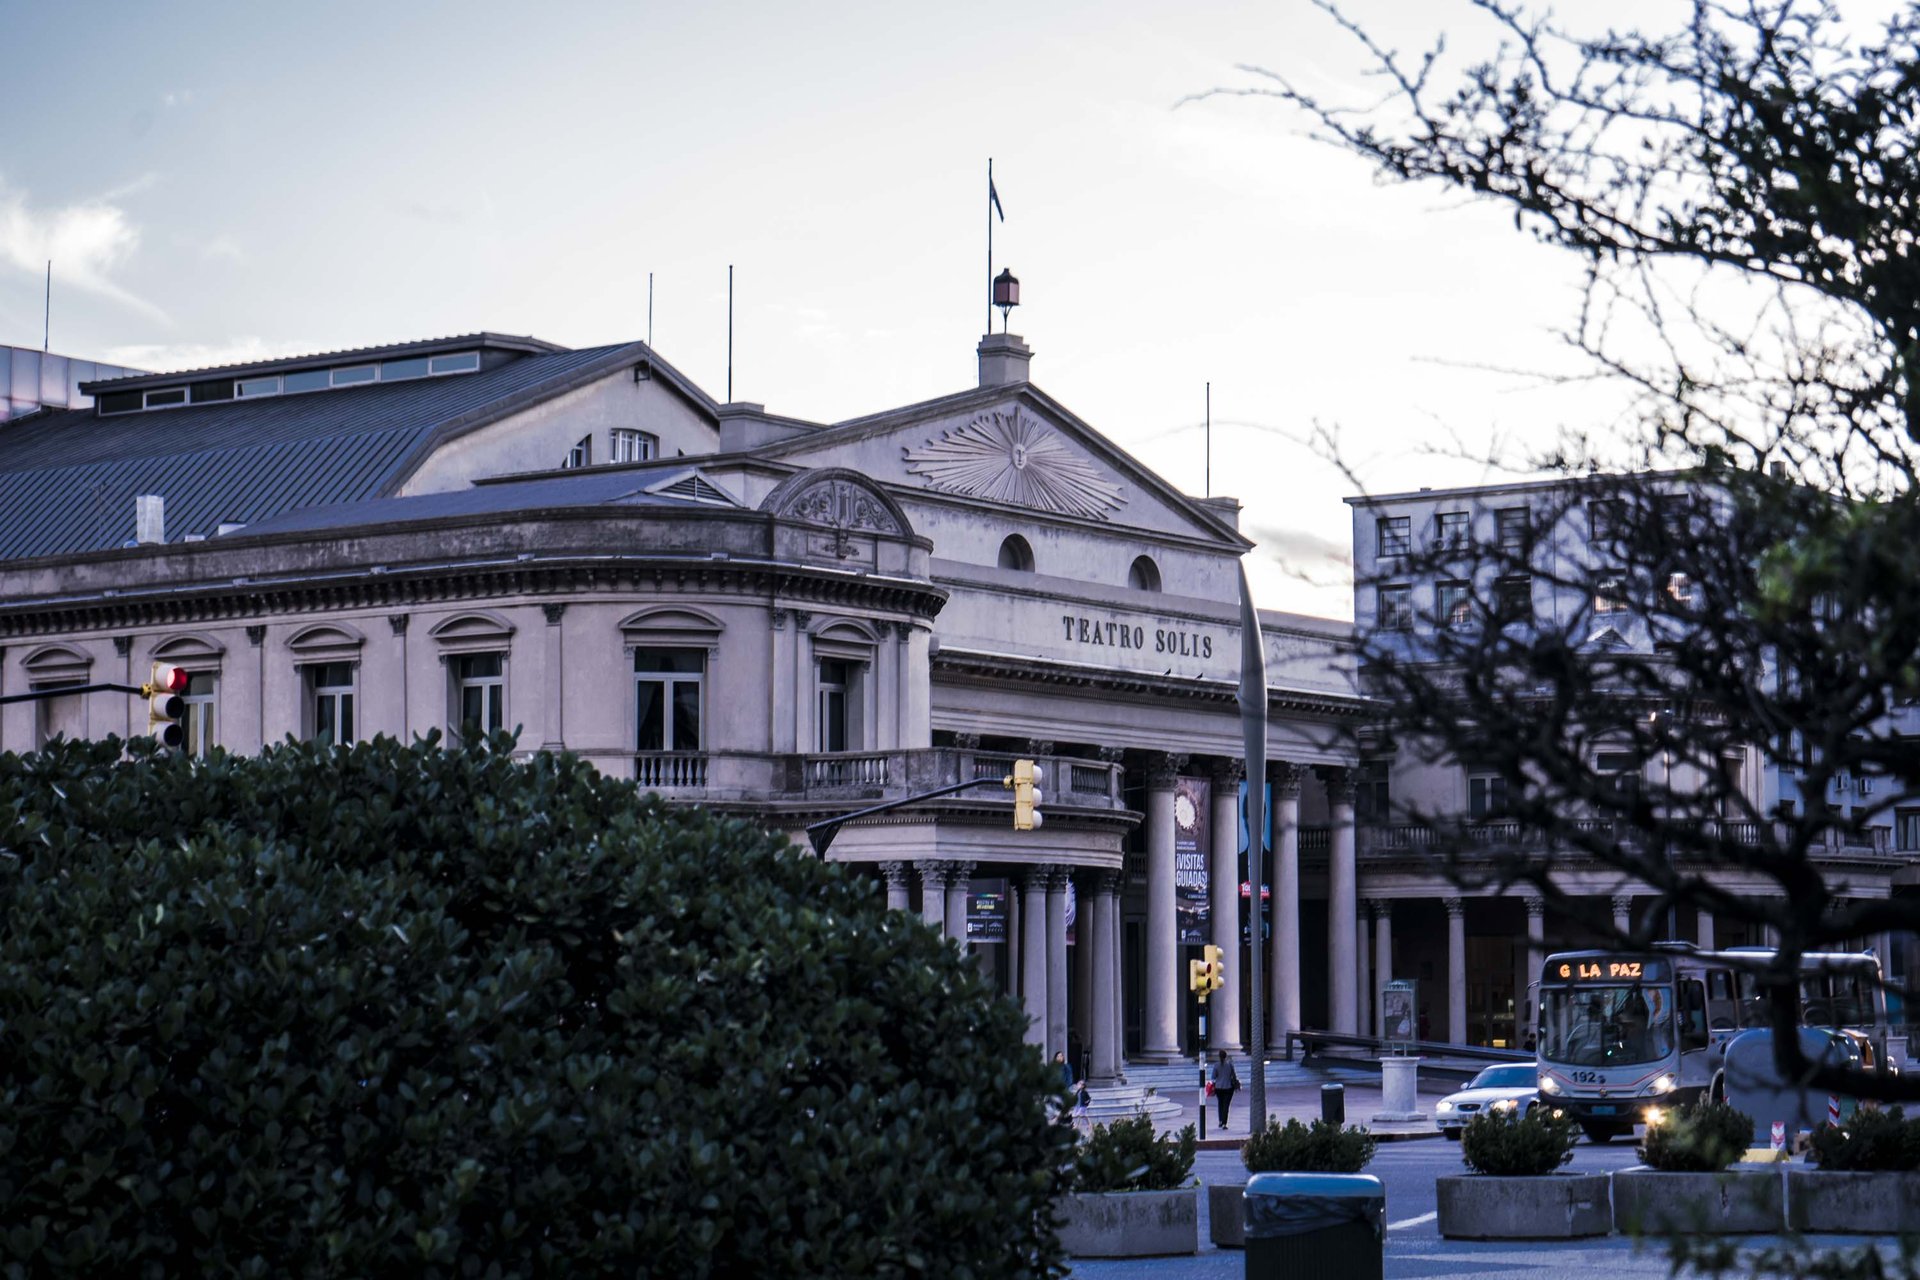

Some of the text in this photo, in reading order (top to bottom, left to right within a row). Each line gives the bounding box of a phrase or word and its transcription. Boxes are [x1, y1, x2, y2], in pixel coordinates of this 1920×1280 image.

[1063, 615, 1212, 659] TEATRO SOLIS
[1560, 962, 1641, 978] G LA PAZ
[1571, 1071, 1596, 1083] 192
